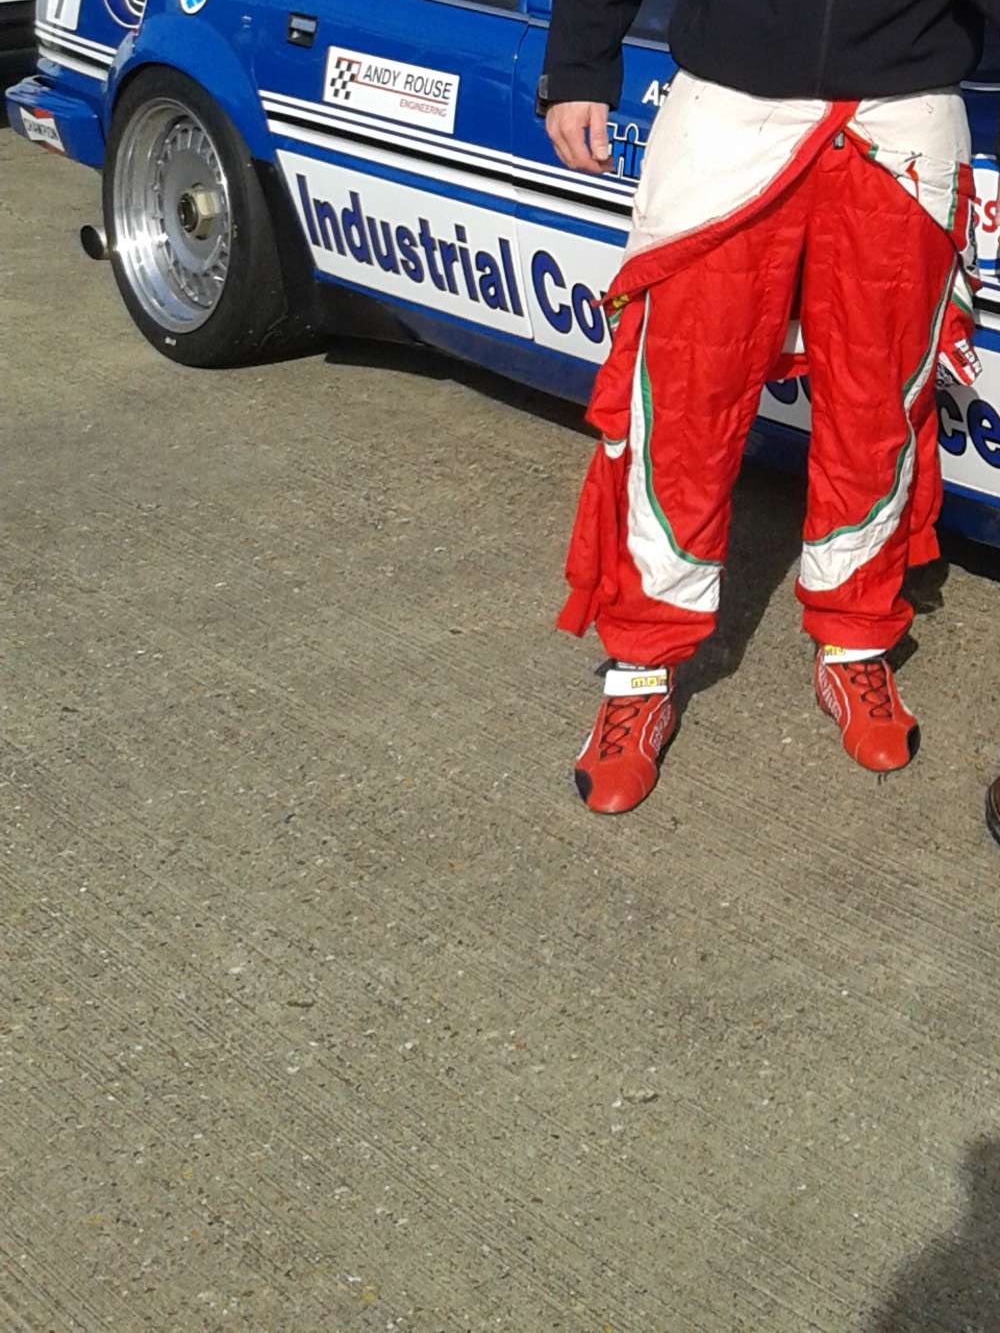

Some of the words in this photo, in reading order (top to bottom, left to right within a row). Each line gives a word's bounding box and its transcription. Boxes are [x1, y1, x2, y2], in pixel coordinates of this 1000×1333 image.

[362, 64, 401, 87] ANDY
[403, 73, 453, 100] ROUSE
[399, 98, 448, 118] ENGINEERING
[296, 173, 526, 317] Industrial
[531, 249, 609, 345] Co
